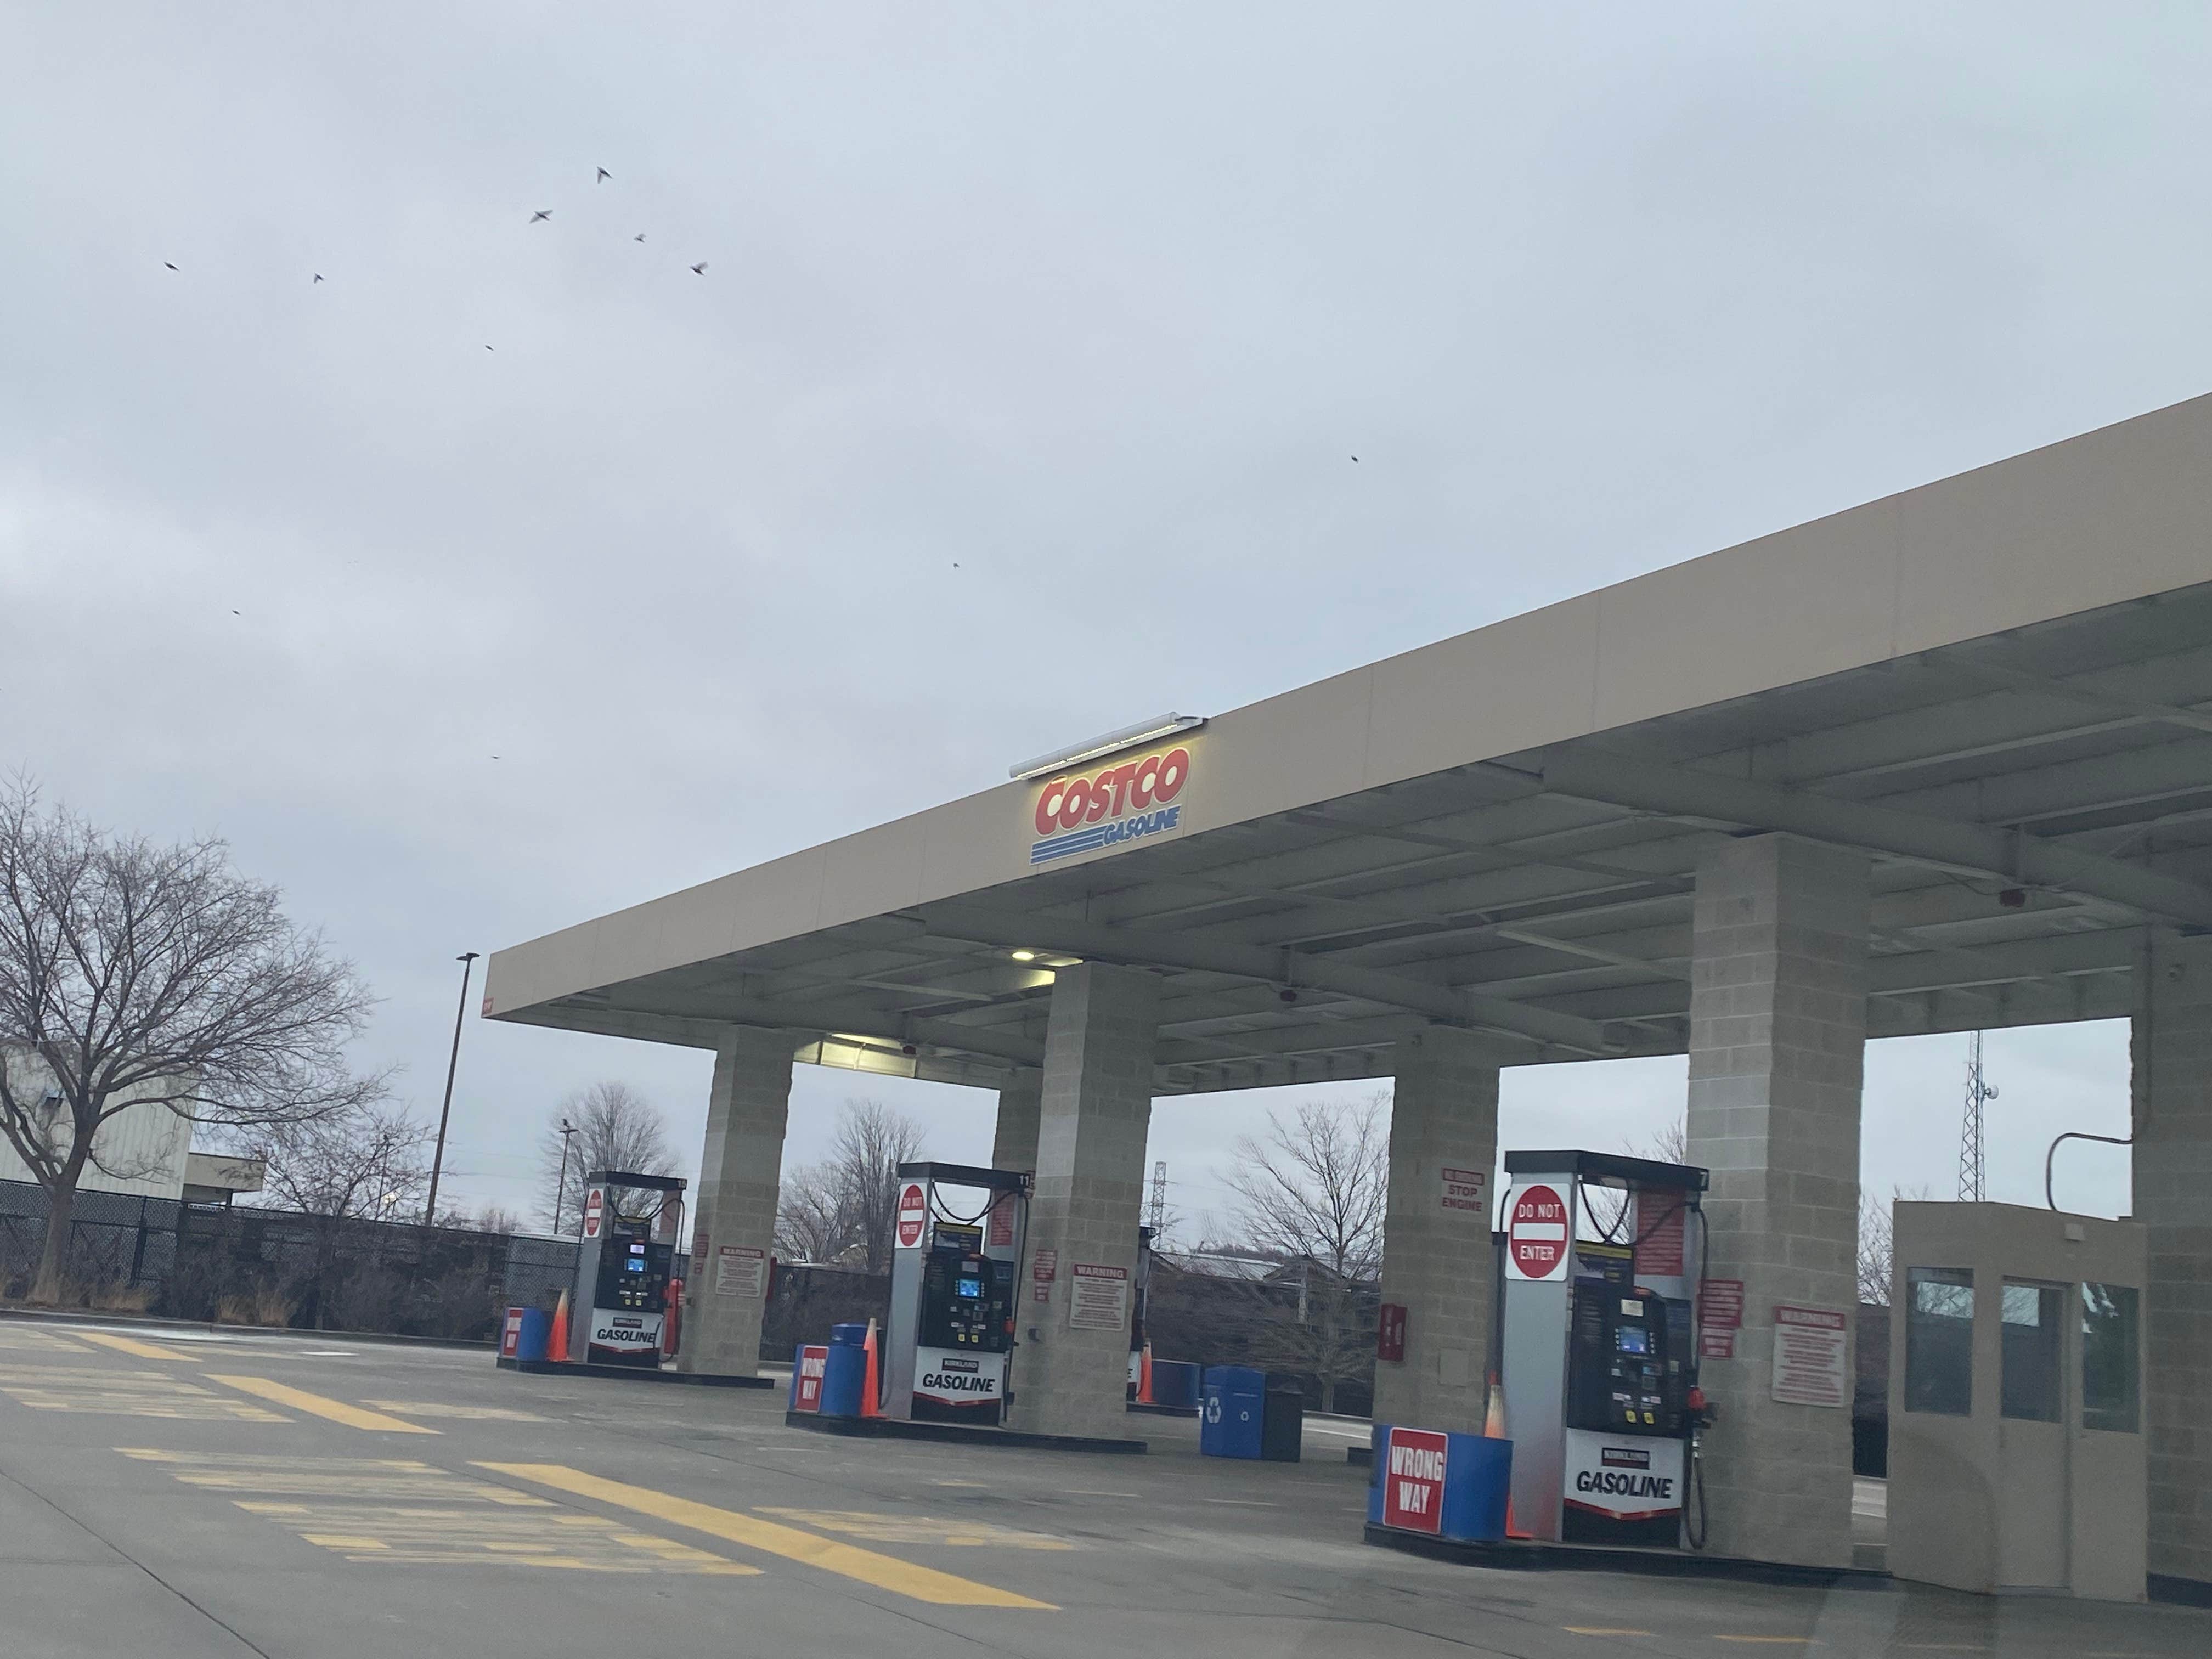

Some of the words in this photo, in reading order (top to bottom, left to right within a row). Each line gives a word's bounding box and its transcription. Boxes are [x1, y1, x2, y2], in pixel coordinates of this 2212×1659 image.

[1035, 747, 1190, 837] COSTCO
[1103, 805, 1181, 845] GASOLINE
[1019, 1175, 1030, 1186] 11
[1448, 1184, 1477, 1197] STOP
[1442, 1197, 1482, 1211] ENGINE
[1519, 1204, 1534, 1218] DO
[1537, 1204, 1561, 1218] NOT
[1520, 1246, 1555, 1261] ENTER
[1077, 1266, 1124, 1278] WARNING
[597, 1328, 656, 1343] GASOLINE
[922, 1373, 995, 1392] GASOLINE
[1392, 1446, 1444, 1481] WRONG
[1577, 1471, 1673, 1499] GASOLINE
[1399, 1481, 1431, 1514] WAY
